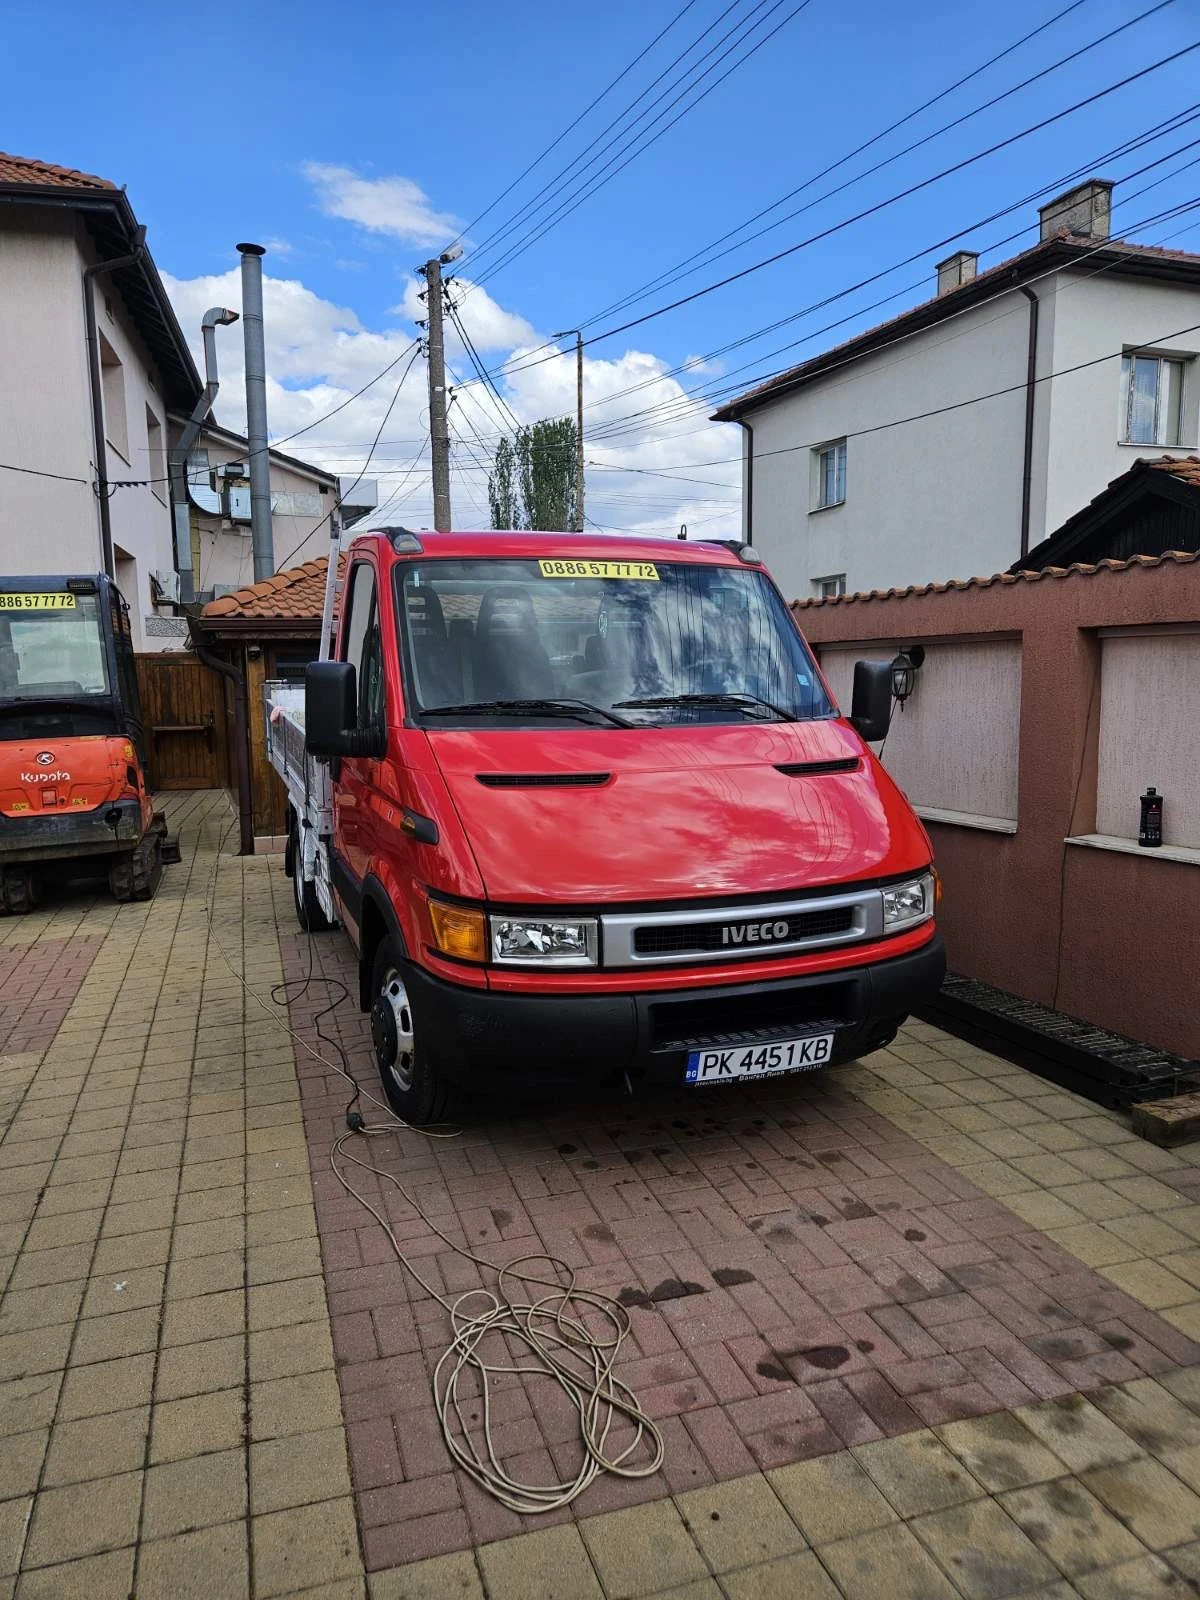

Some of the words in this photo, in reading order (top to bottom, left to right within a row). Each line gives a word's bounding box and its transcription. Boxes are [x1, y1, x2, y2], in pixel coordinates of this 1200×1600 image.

[542, 561, 587, 575] 0886
[589, 562, 608, 576] 57
[24, 595, 39, 607] 57
[42, 595, 56, 607] 77
[59, 595, 74, 607] 72
[722, 921, 789, 944] IVECO
[701, 1051, 735, 1077] PK
[739, 1043, 796, 1072] 4451
[799, 1038, 829, 1064] KB
[685, 1070, 697, 1079] BG
